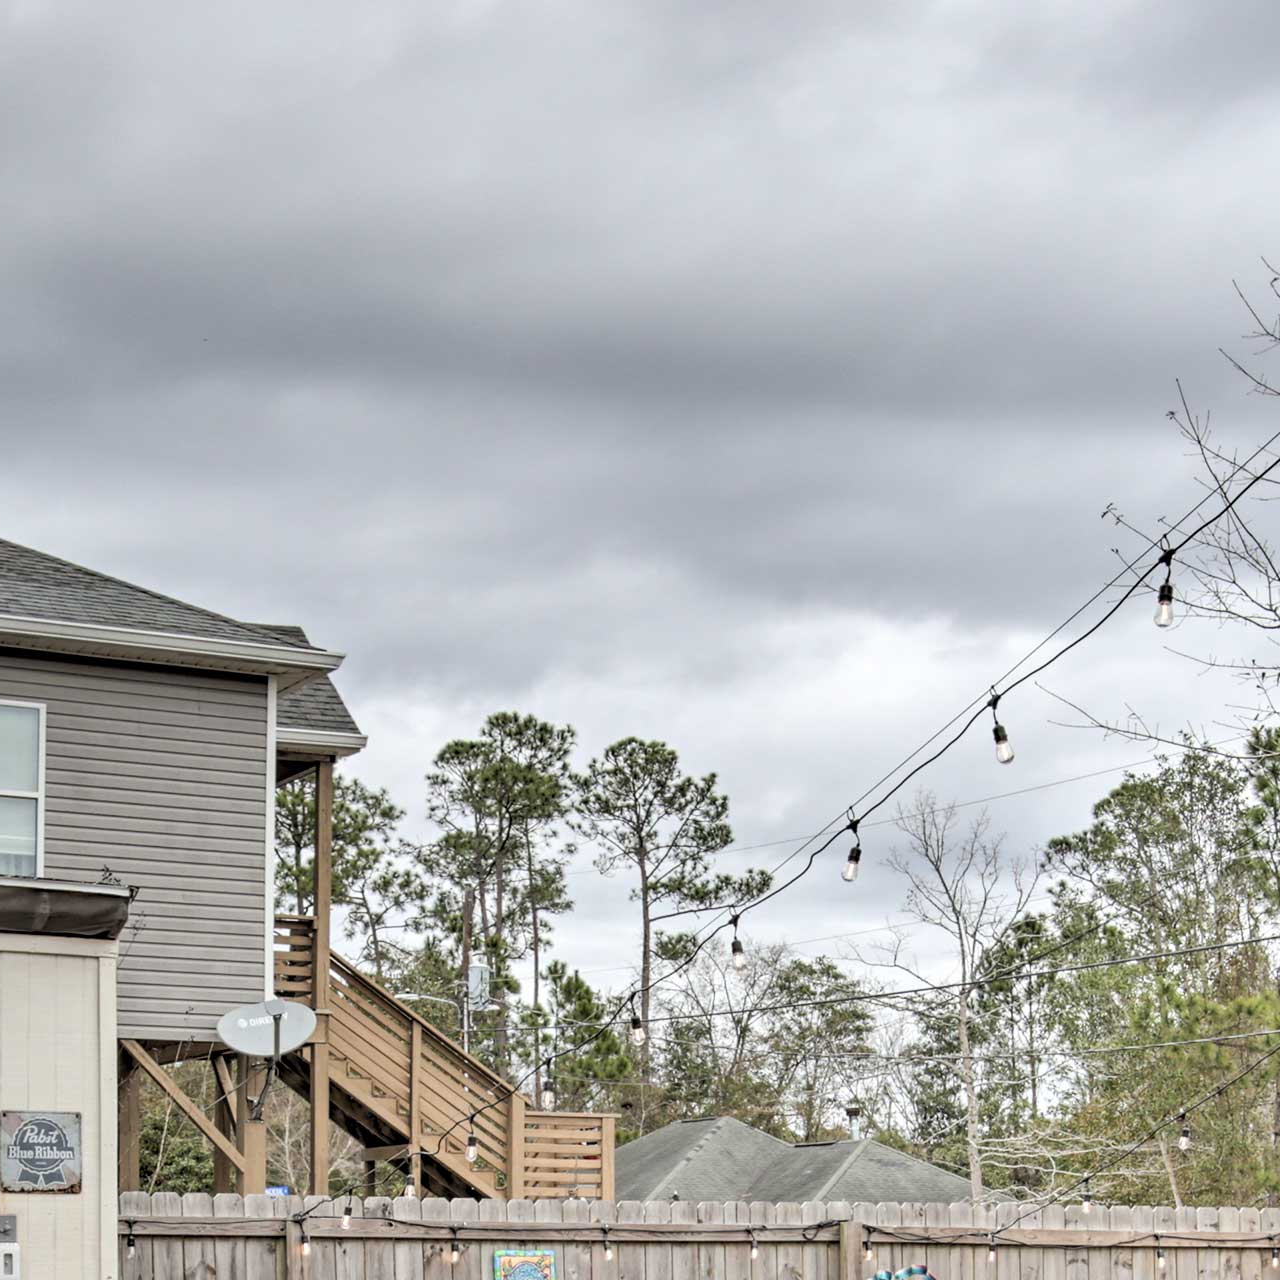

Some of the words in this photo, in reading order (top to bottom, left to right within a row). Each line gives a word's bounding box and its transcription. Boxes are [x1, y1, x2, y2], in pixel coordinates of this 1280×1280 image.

[23, 1125, 58, 1144] Pabst
[8, 1146, 34, 1159] Blue
[34, 1146, 74, 1160] Ribbon
